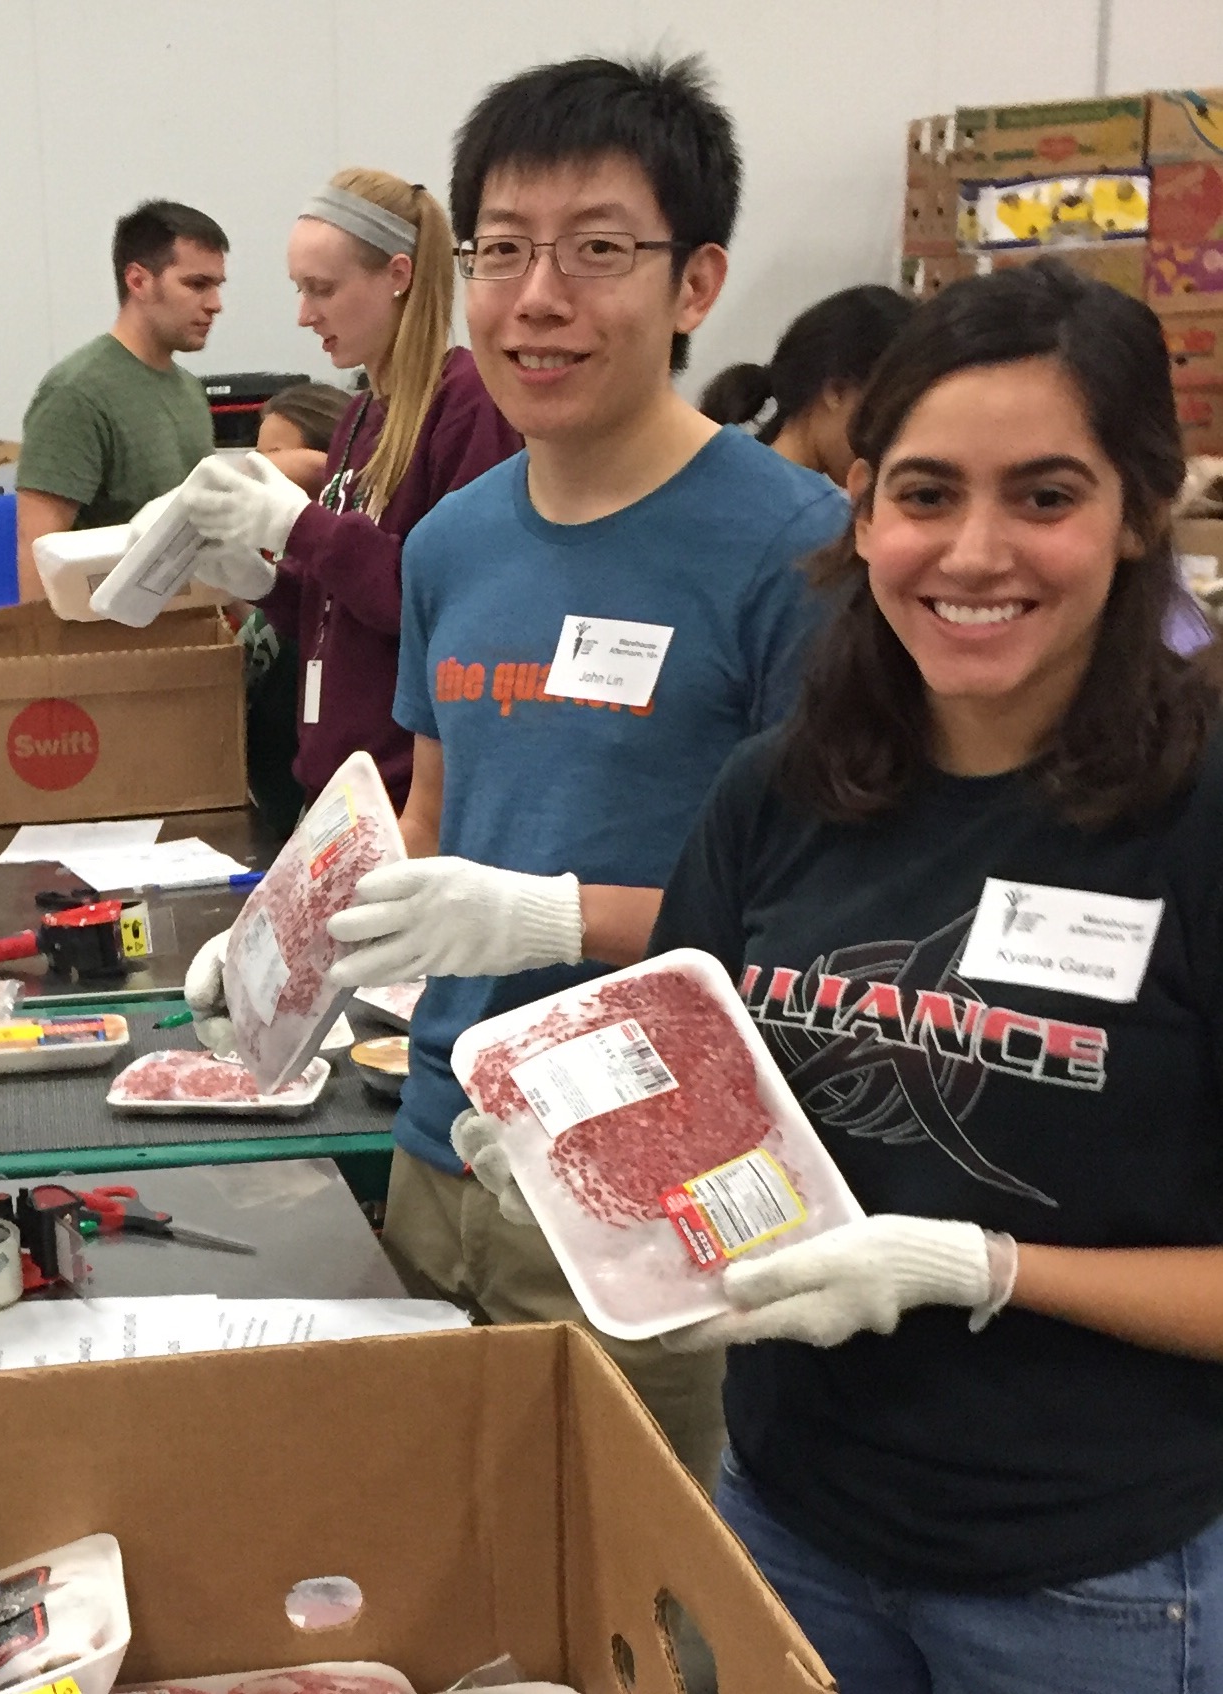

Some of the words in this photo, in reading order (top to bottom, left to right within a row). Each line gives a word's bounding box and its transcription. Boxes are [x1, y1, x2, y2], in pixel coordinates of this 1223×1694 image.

[436, 656, 485, 702] the
[579, 671, 605, 684] John
[606, 674, 624, 687] Lin
[14, 731, 93, 758] Swift
[739, 965, 1109, 1092] LLIANCE
